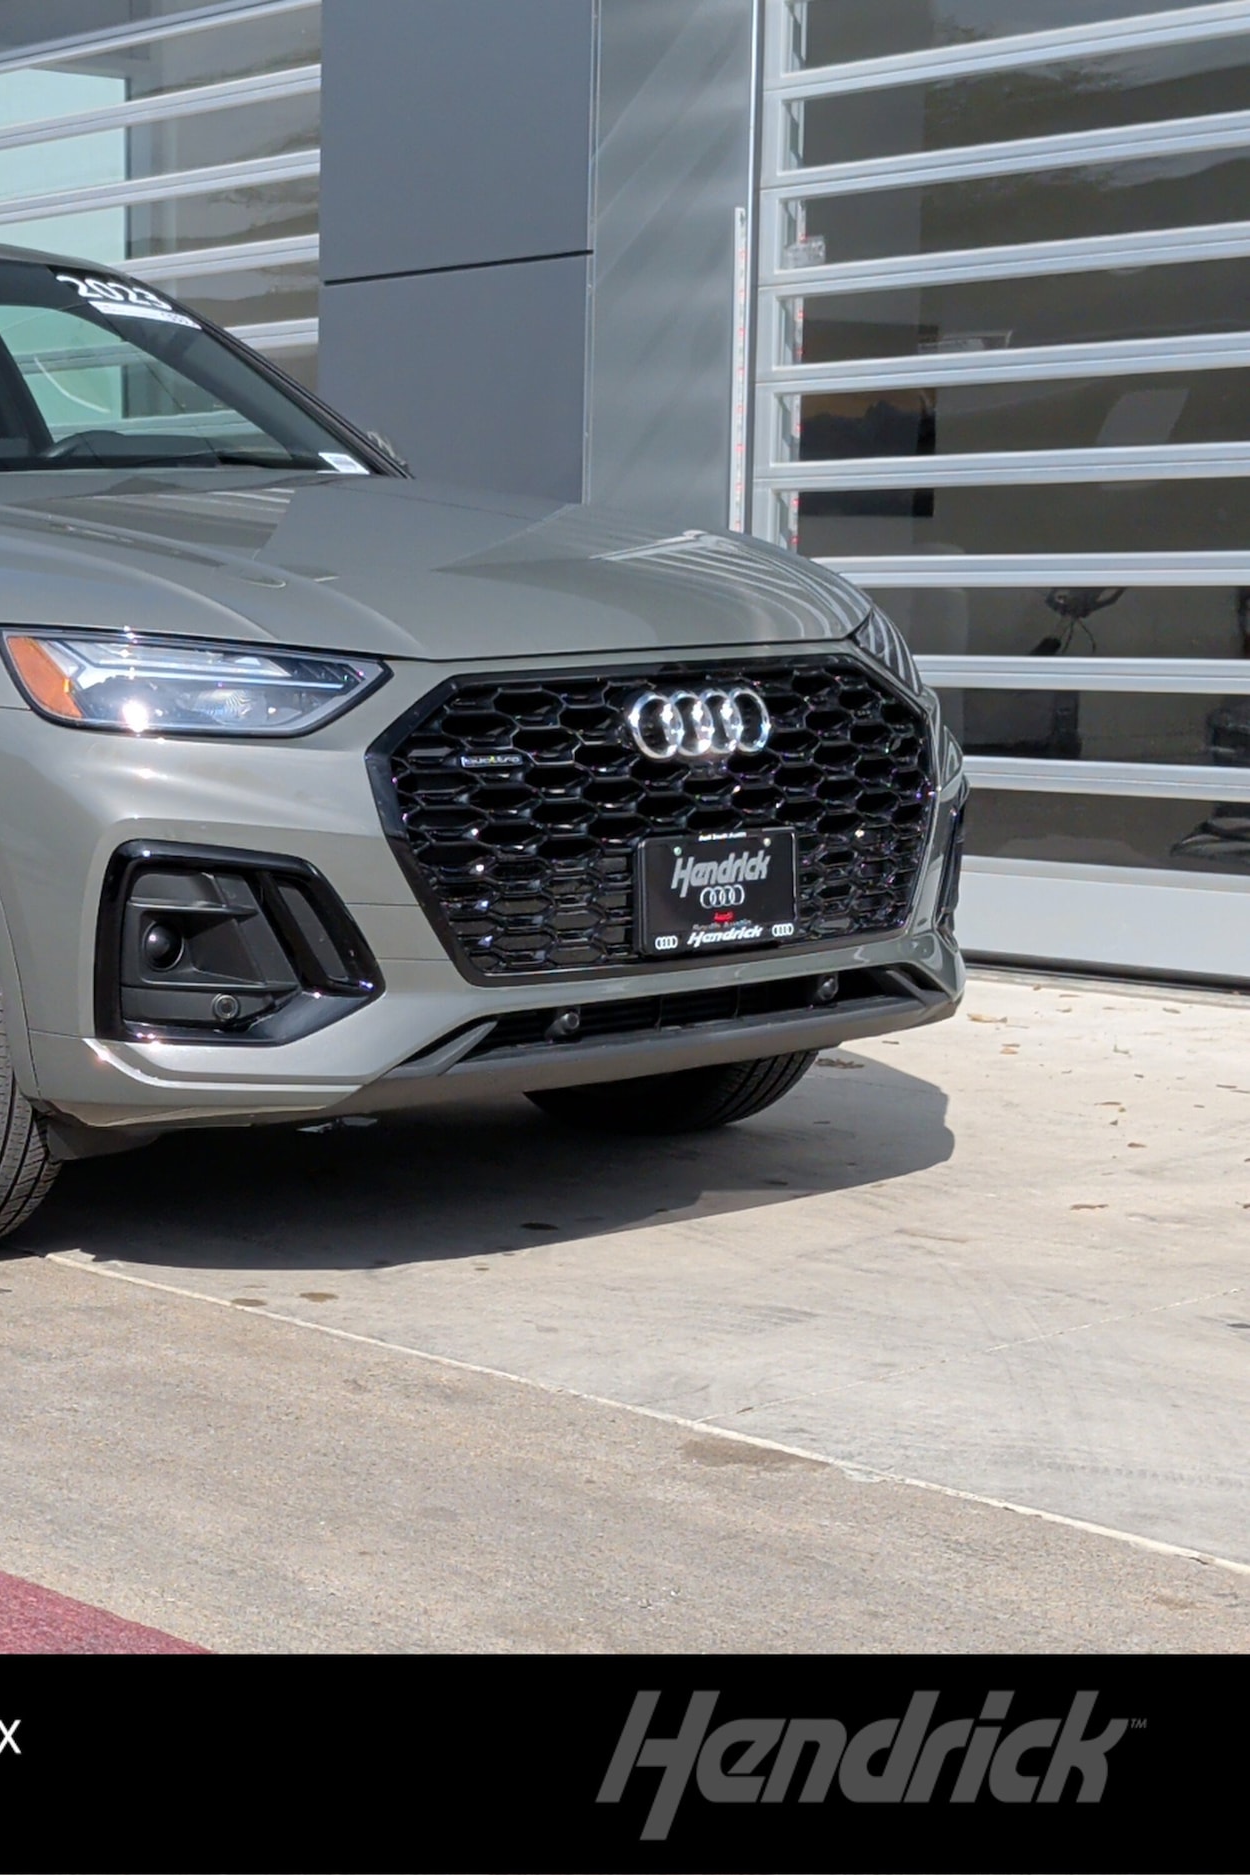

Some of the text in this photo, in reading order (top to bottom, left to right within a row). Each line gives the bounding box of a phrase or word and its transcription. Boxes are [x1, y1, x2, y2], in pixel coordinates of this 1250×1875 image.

[56, 275, 172, 311] 2023
[671, 850, 771, 898] Hendrick
[687, 925, 763, 948] Hendrick
